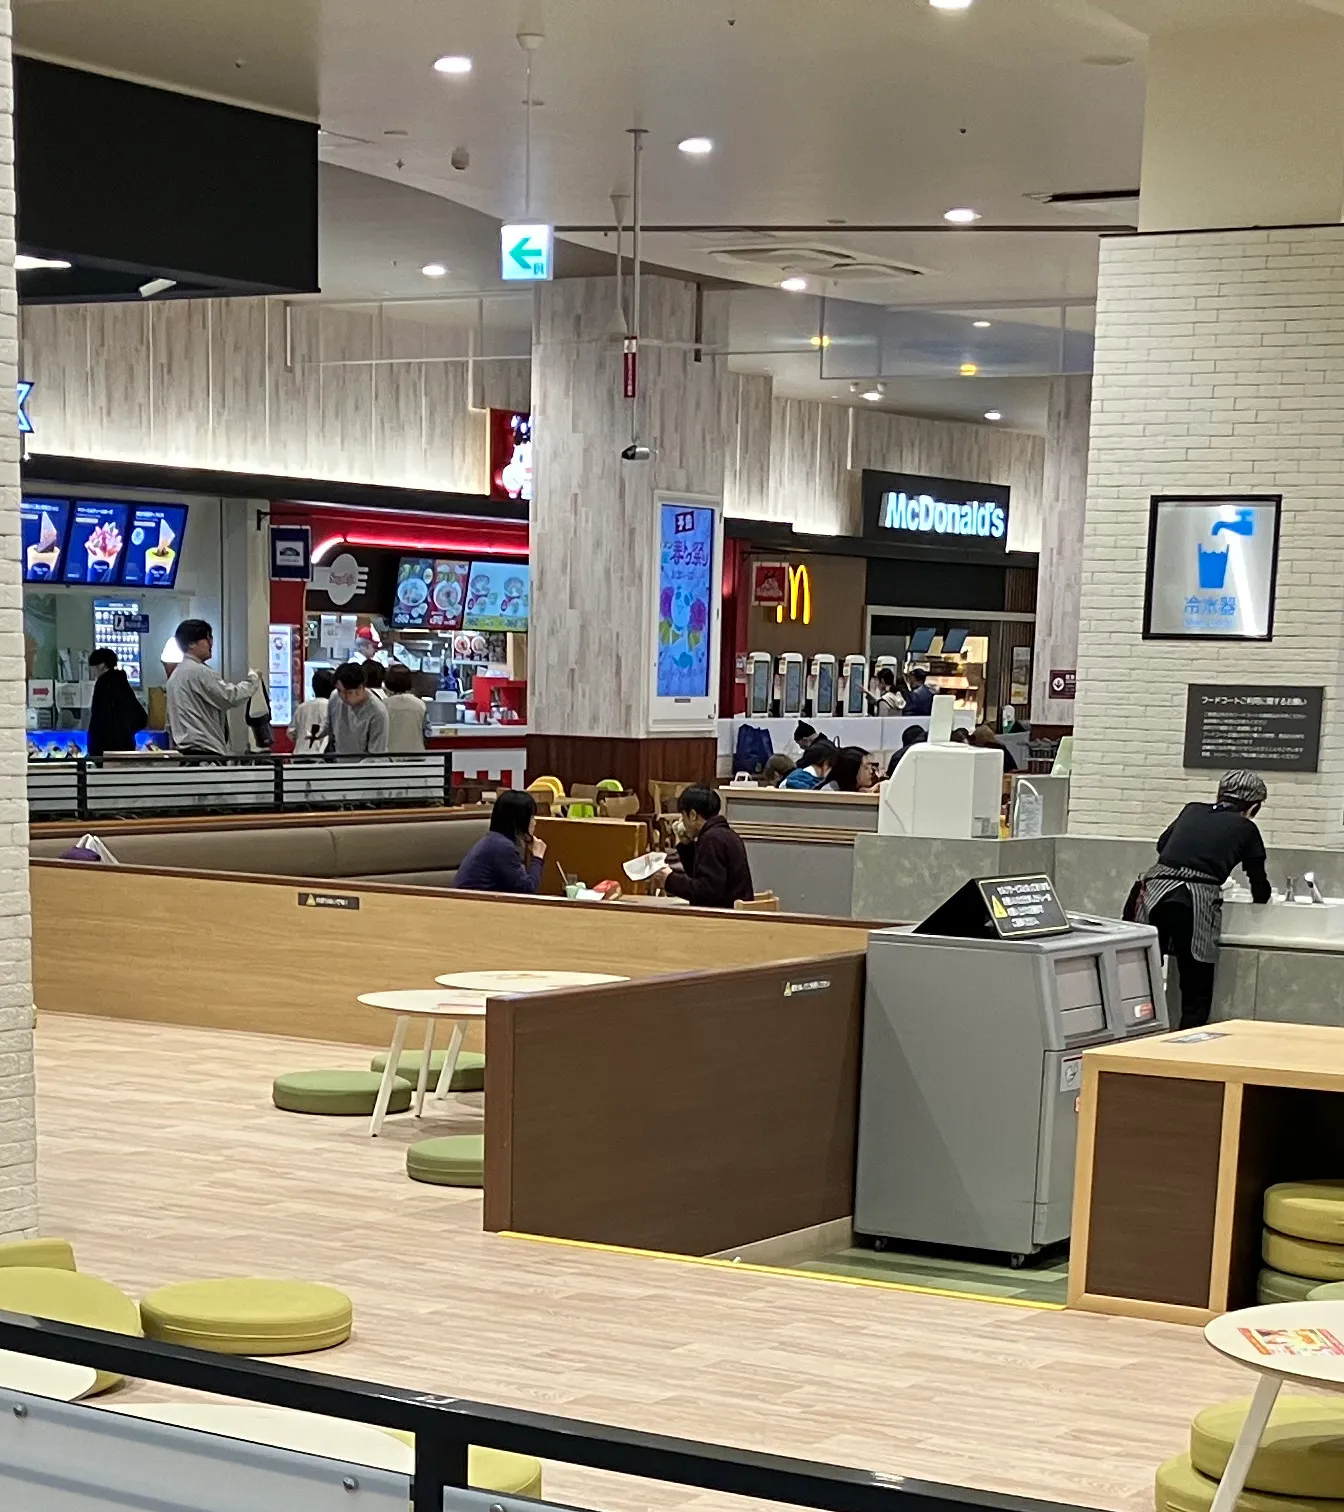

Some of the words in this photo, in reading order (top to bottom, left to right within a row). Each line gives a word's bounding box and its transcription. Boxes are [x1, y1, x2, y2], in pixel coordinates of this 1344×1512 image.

[883, 491, 1005, 538] McDonald's
[1183, 595, 1237, 617] 冷水器
